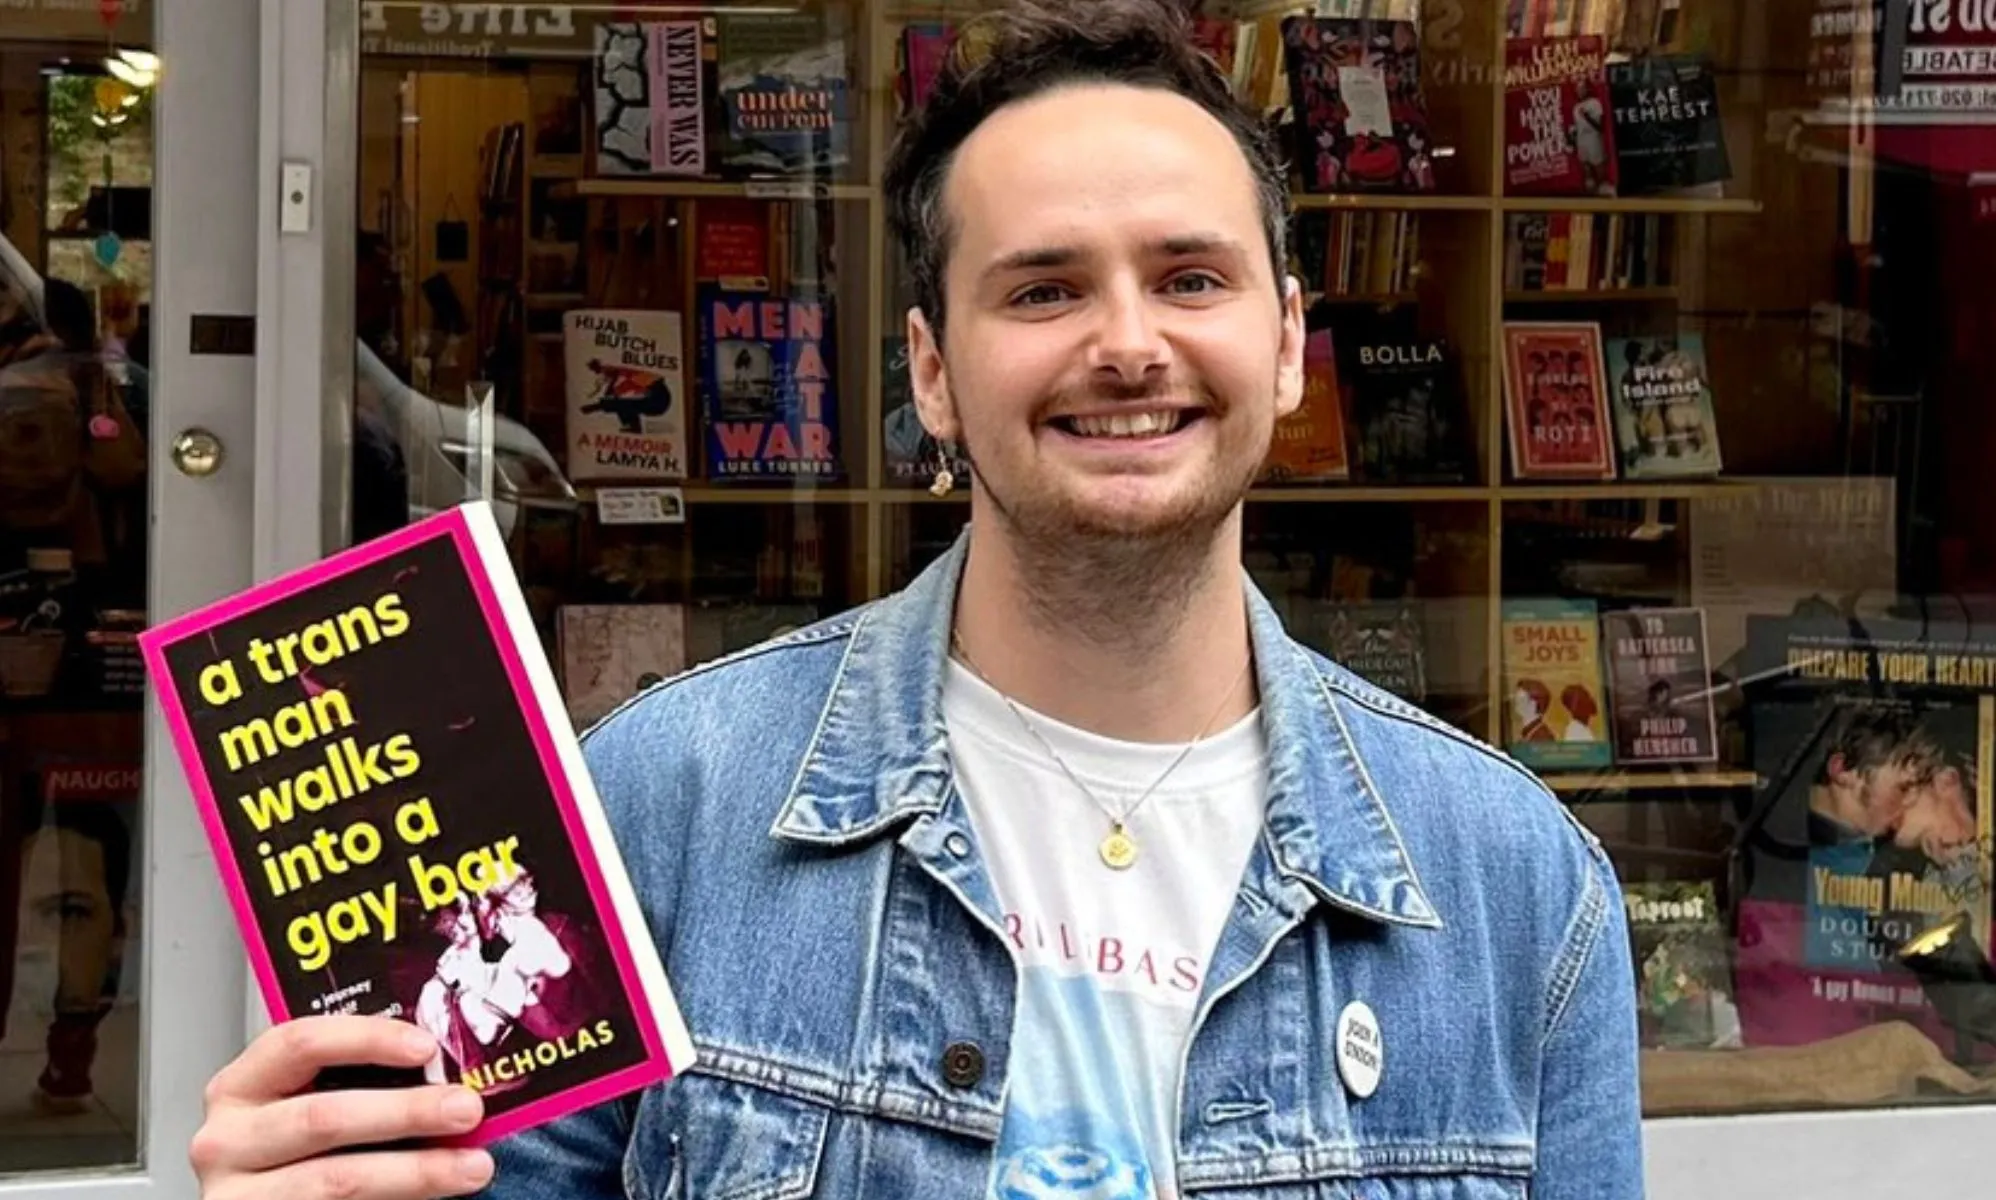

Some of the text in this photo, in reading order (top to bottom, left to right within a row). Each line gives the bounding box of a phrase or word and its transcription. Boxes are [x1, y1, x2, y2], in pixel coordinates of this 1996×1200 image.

[1531, 40, 1578, 64] LEAH
[737, 85, 834, 111] under
[1527, 86, 1562, 106] YOU
[1637, 86, 1679, 105] KAE
[1613, 101, 1713, 124] TEMPEST
[669, 114, 700, 167] WAS
[575, 315, 629, 333] HIJAB
[712, 300, 824, 341] MEN
[595, 333, 657, 352] BUTCH
[621, 351, 679, 370] BLUES
[1359, 343, 1444, 366] BOLLA
[1633, 365, 1684, 383] Fire
[1622, 377, 1702, 399] Island
[576, 432, 673, 454] A MEMOIR
[712, 420, 835, 461] WAR
[596, 452, 660, 471] LAMYA
[717, 460, 834, 474] LUKE TURNER
[1513, 626, 1588, 643] SMALL
[199, 661, 243, 706] a
[249, 592, 411, 687] trans
[1524, 645, 1580, 663] JOYS
[1787, 648, 1871, 681] PREPARE
[1877, 653, 1929, 684] YOUR
[218, 689, 357, 772] man
[239, 733, 422, 832] walks
[257, 797, 441, 897] into a
[286, 832, 521, 972] gay bar
[1814, 867, 1885, 919] Young
[1346, 1017, 1372, 1043] JOIN
[461, 1019, 617, 1092] NICHOLAS
